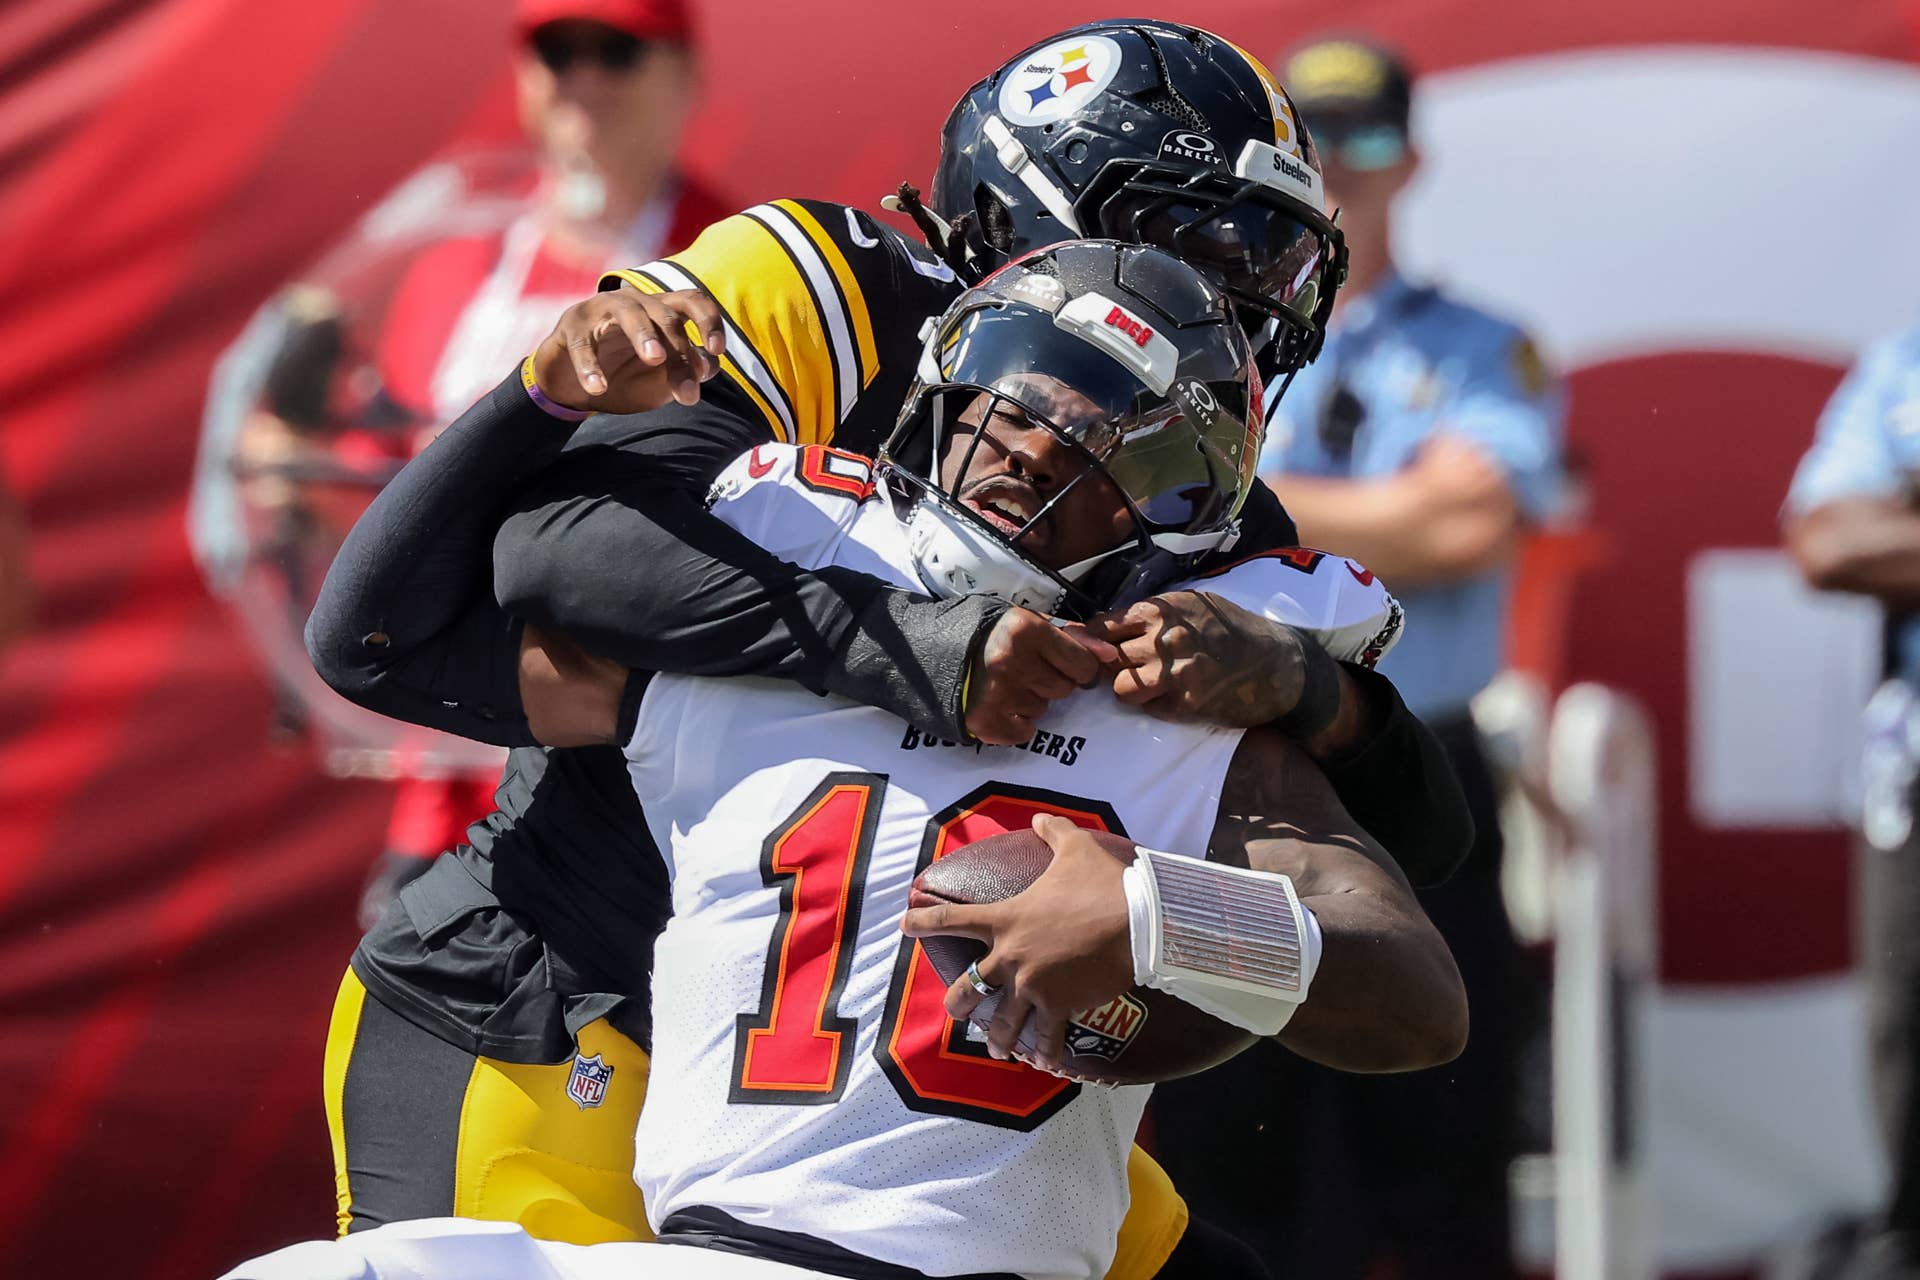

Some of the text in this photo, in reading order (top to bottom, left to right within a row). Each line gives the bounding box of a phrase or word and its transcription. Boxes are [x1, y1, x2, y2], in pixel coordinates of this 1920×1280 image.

[1163, 143, 1222, 165] OAKLEY
[1273, 152, 1312, 189] Steelers
[1176, 382, 1214, 427] OAKLEY
[727, 771, 1131, 1133] 10
[573, 1074, 601, 1101] NFL
